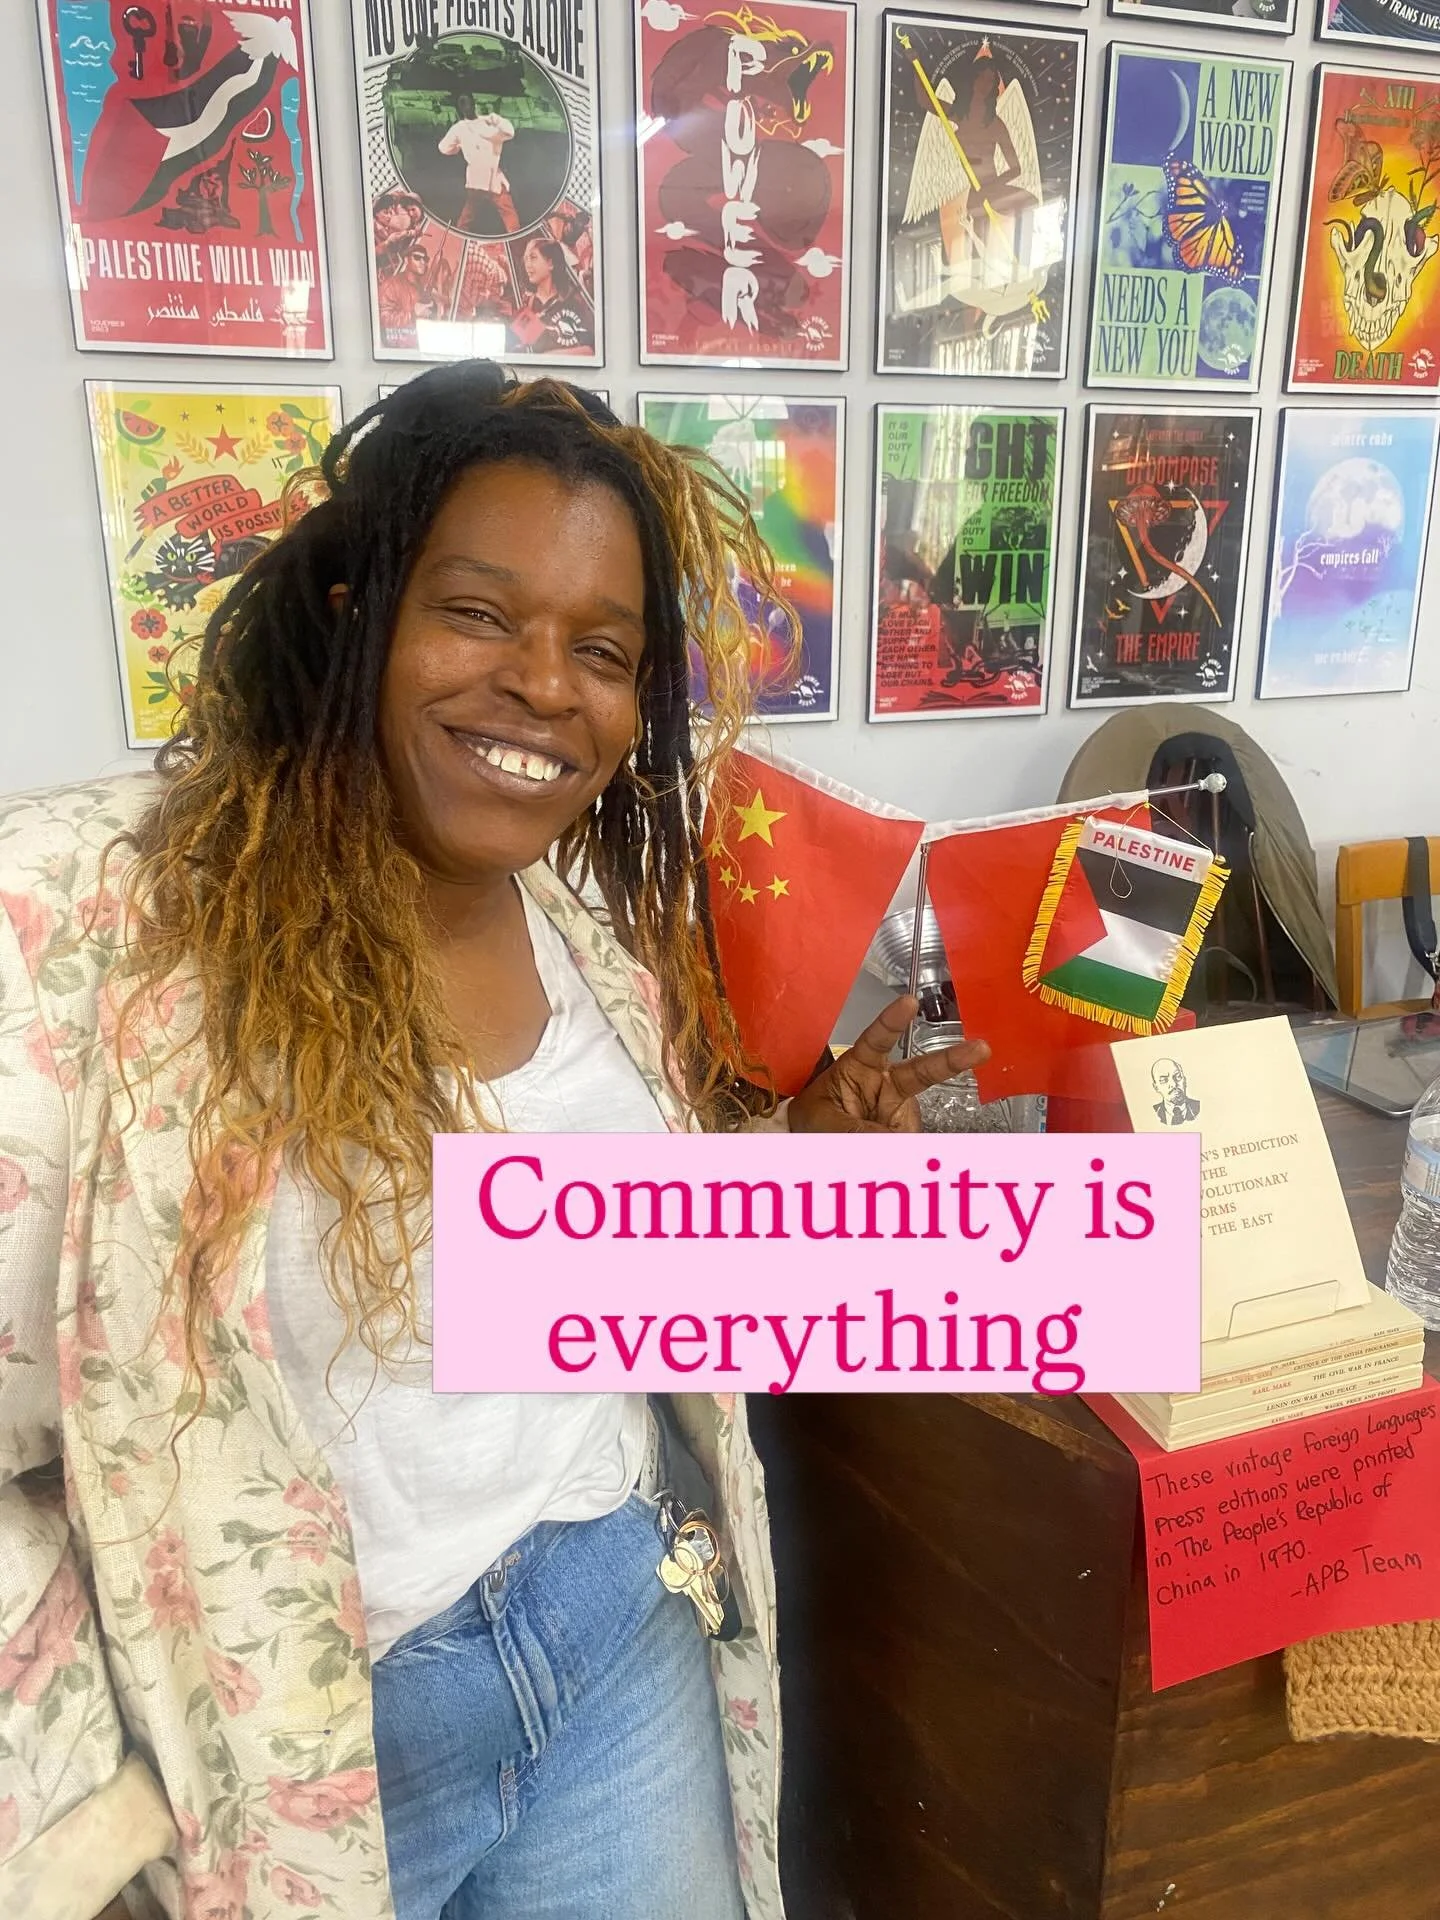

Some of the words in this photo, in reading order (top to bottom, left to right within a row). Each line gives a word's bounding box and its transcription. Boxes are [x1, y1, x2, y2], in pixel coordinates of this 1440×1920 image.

[366, 0, 396, 57] NO
[522, 0, 585, 79] ALONE
[1419, 12, 1440, 30] LIVE
[1202, 66, 1216, 118] A
[1228, 69, 1280, 123] NEW
[1200, 121, 1273, 175] WORLD
[722, 33, 768, 336] POWER
[84, 238, 203, 283] PALESTINE
[209, 244, 263, 286] WILL
[269, 248, 315, 288] WIN
[1101, 273, 1168, 325] NEEDS
[1176, 278, 1189, 325] A
[1096, 325, 1148, 374] NEW
[1157, 328, 1196, 376] YOU
[1333, 350, 1404, 380] DEATH
[152, 505, 167, 521] A
[168, 479, 235, 511] BETTER
[187, 496, 248, 531] WORLD
[217, 525, 234, 538] IS
[959, 553, 1046, 605] WIN
[1116, 634, 1143, 664] THE
[1147, 631, 1201, 662] EMPIRE
[1092, 831, 1196, 873] PALESTINE
[1223, 1133, 1299, 1158] PREDICTION
[1201, 1166, 1228, 1180] THE
[1208, 1221, 1237, 1236] THE
[1241, 1213, 1273, 1229] EAST
[1252, 1386, 1270, 1396] KARL
[1272, 1381, 1292, 1390] MARX
[1313, 1373, 1327, 1381] THE
[1328, 1369, 1346, 1378] CIVIL
[1348, 1365, 1362, 1373] WAR
[1374, 1356, 1400, 1367] FRANCE
[1266, 1401, 1288, 1411] LENIN
[1290, 1398, 1301, 1406] ON
[1303, 1394, 1318, 1402] WAR
[1320, 1390, 1335, 1398] AND
[1336, 1384, 1358, 1394] PEACE
[1146, 1469, 1214, 1499] These
[1225, 1447, 1293, 1478] vintage
[1367, 1404, 1436, 1435] Languages
[1218, 1481, 1289, 1516] editions
[1296, 1465, 1342, 1492] were
[1353, 1435, 1415, 1481] printed
[1154, 1547, 1172, 1569] in
[1175, 1535, 1213, 1559] The
[1222, 1508, 1289, 1545] People's
[1296, 1486, 1364, 1526] Republic
[1372, 1472, 1394, 1499] of
[1352, 1543, 1423, 1577] Team
[1157, 1571, 1217, 1606] China
[1225, 1563, 1241, 1584] in
